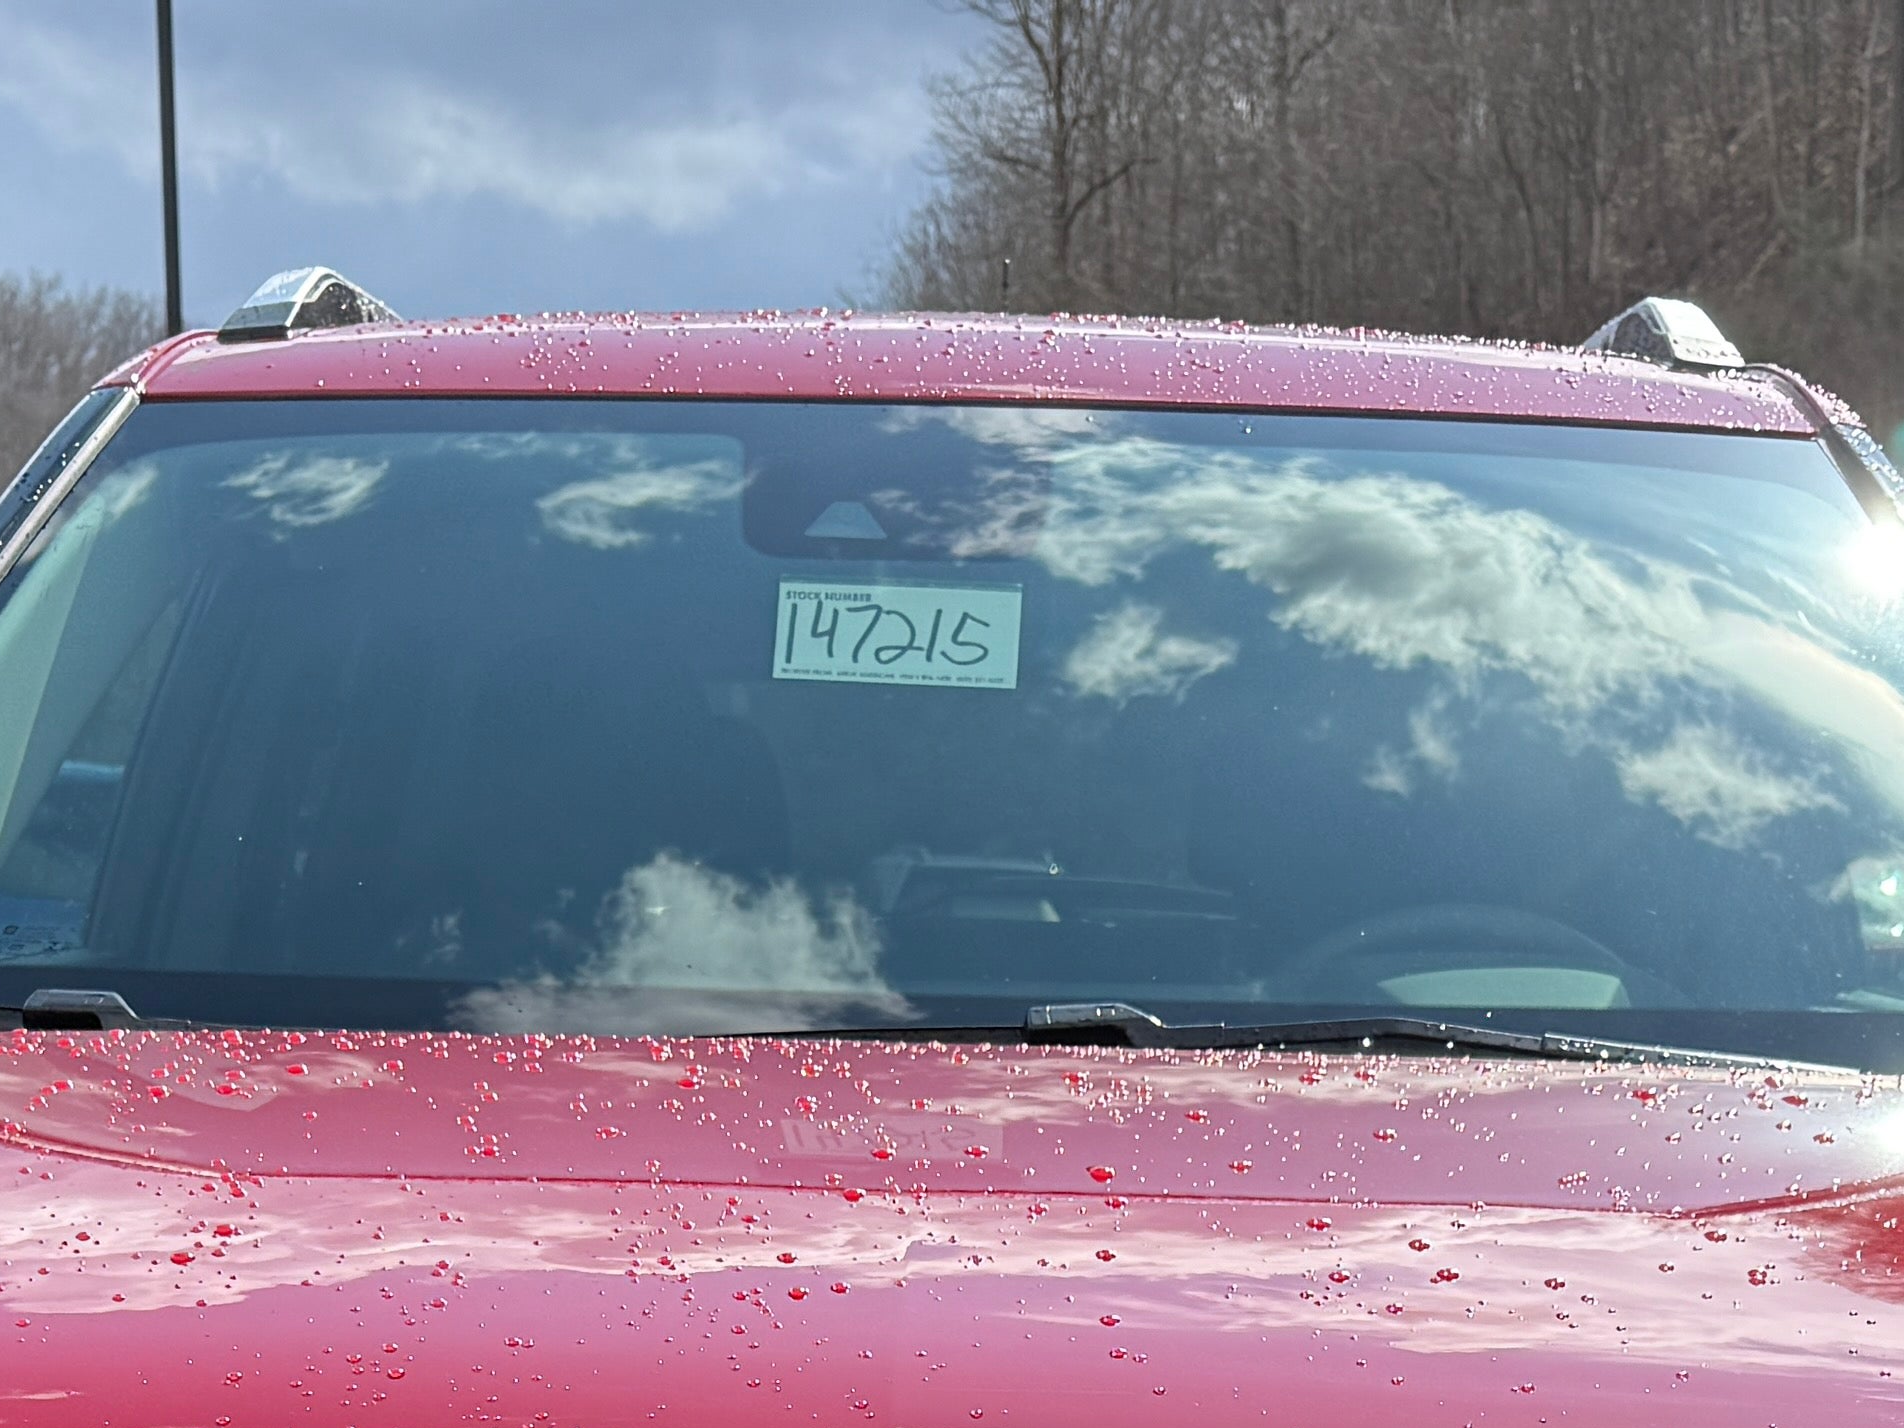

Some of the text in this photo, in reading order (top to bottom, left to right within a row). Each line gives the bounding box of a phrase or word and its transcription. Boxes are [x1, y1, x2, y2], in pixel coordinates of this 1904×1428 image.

[785, 590, 872, 602] STOCK NUMBER
[785, 600, 991, 666] 147215
